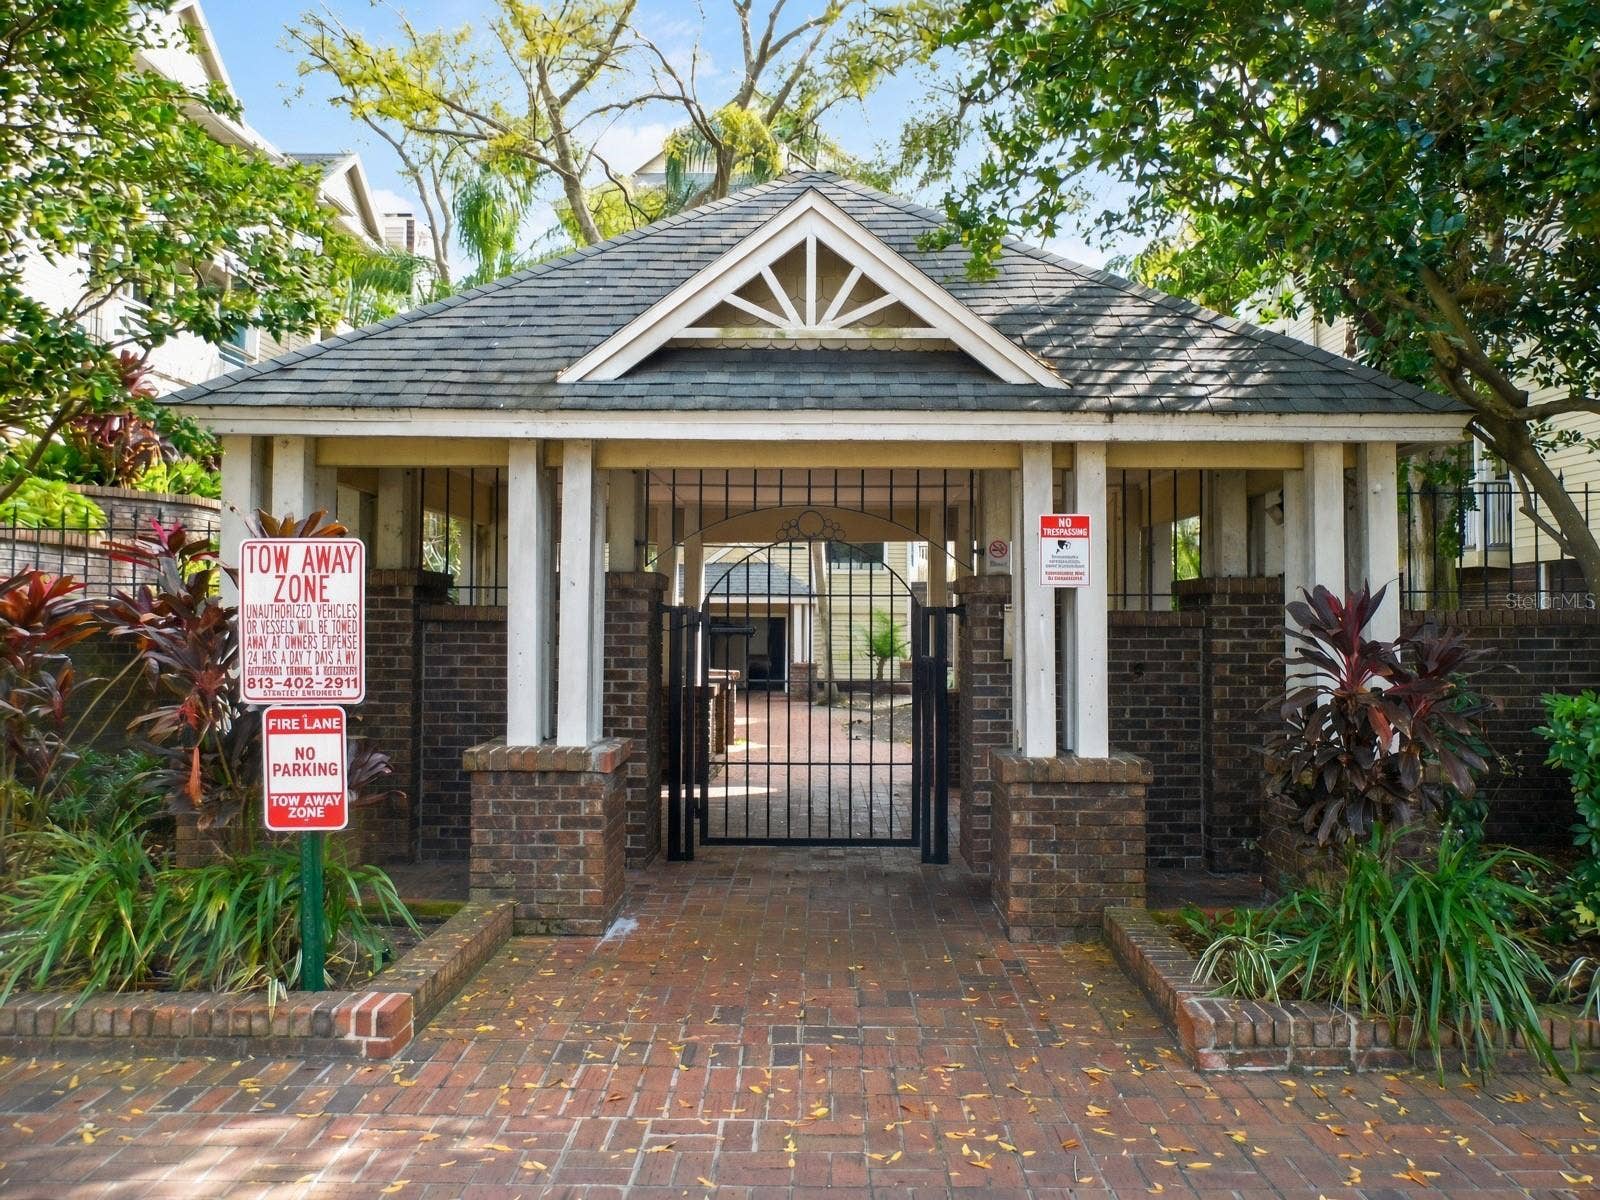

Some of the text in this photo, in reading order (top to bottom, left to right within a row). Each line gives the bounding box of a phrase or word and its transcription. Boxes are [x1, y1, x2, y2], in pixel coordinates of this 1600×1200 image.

[1058, 518, 1072, 527] NO
[1043, 528, 1088, 536] TRESPASSING
[247, 545, 357, 573] TOW AWAY
[274, 575, 330, 603] ZONE
[246, 604, 358, 619] UNAUTHORIZED VEHICLES
[247, 620, 358, 634] OR VESSELS WILL BE TOWED
[247, 635, 268, 649] AWAY
[272, 635, 280, 649] AT
[285, 635, 318, 649] OWNERS
[248, 651, 257, 664] 24
[281, 651, 286, 664] A
[290, 651, 303, 664] DAY
[306, 651, 311, 664] 7
[315, 651, 333, 664] DAYS
[337, 651, 342, 664] A
[247, 677, 358, 689] 813-402-2911
[268, 718, 341, 730] FIRE LANE
[295, 747, 316, 760] NO
[273, 763, 338, 777] PARKING
[271, 794, 342, 806] TOW AWAY
[288, 807, 325, 818] ZONE
